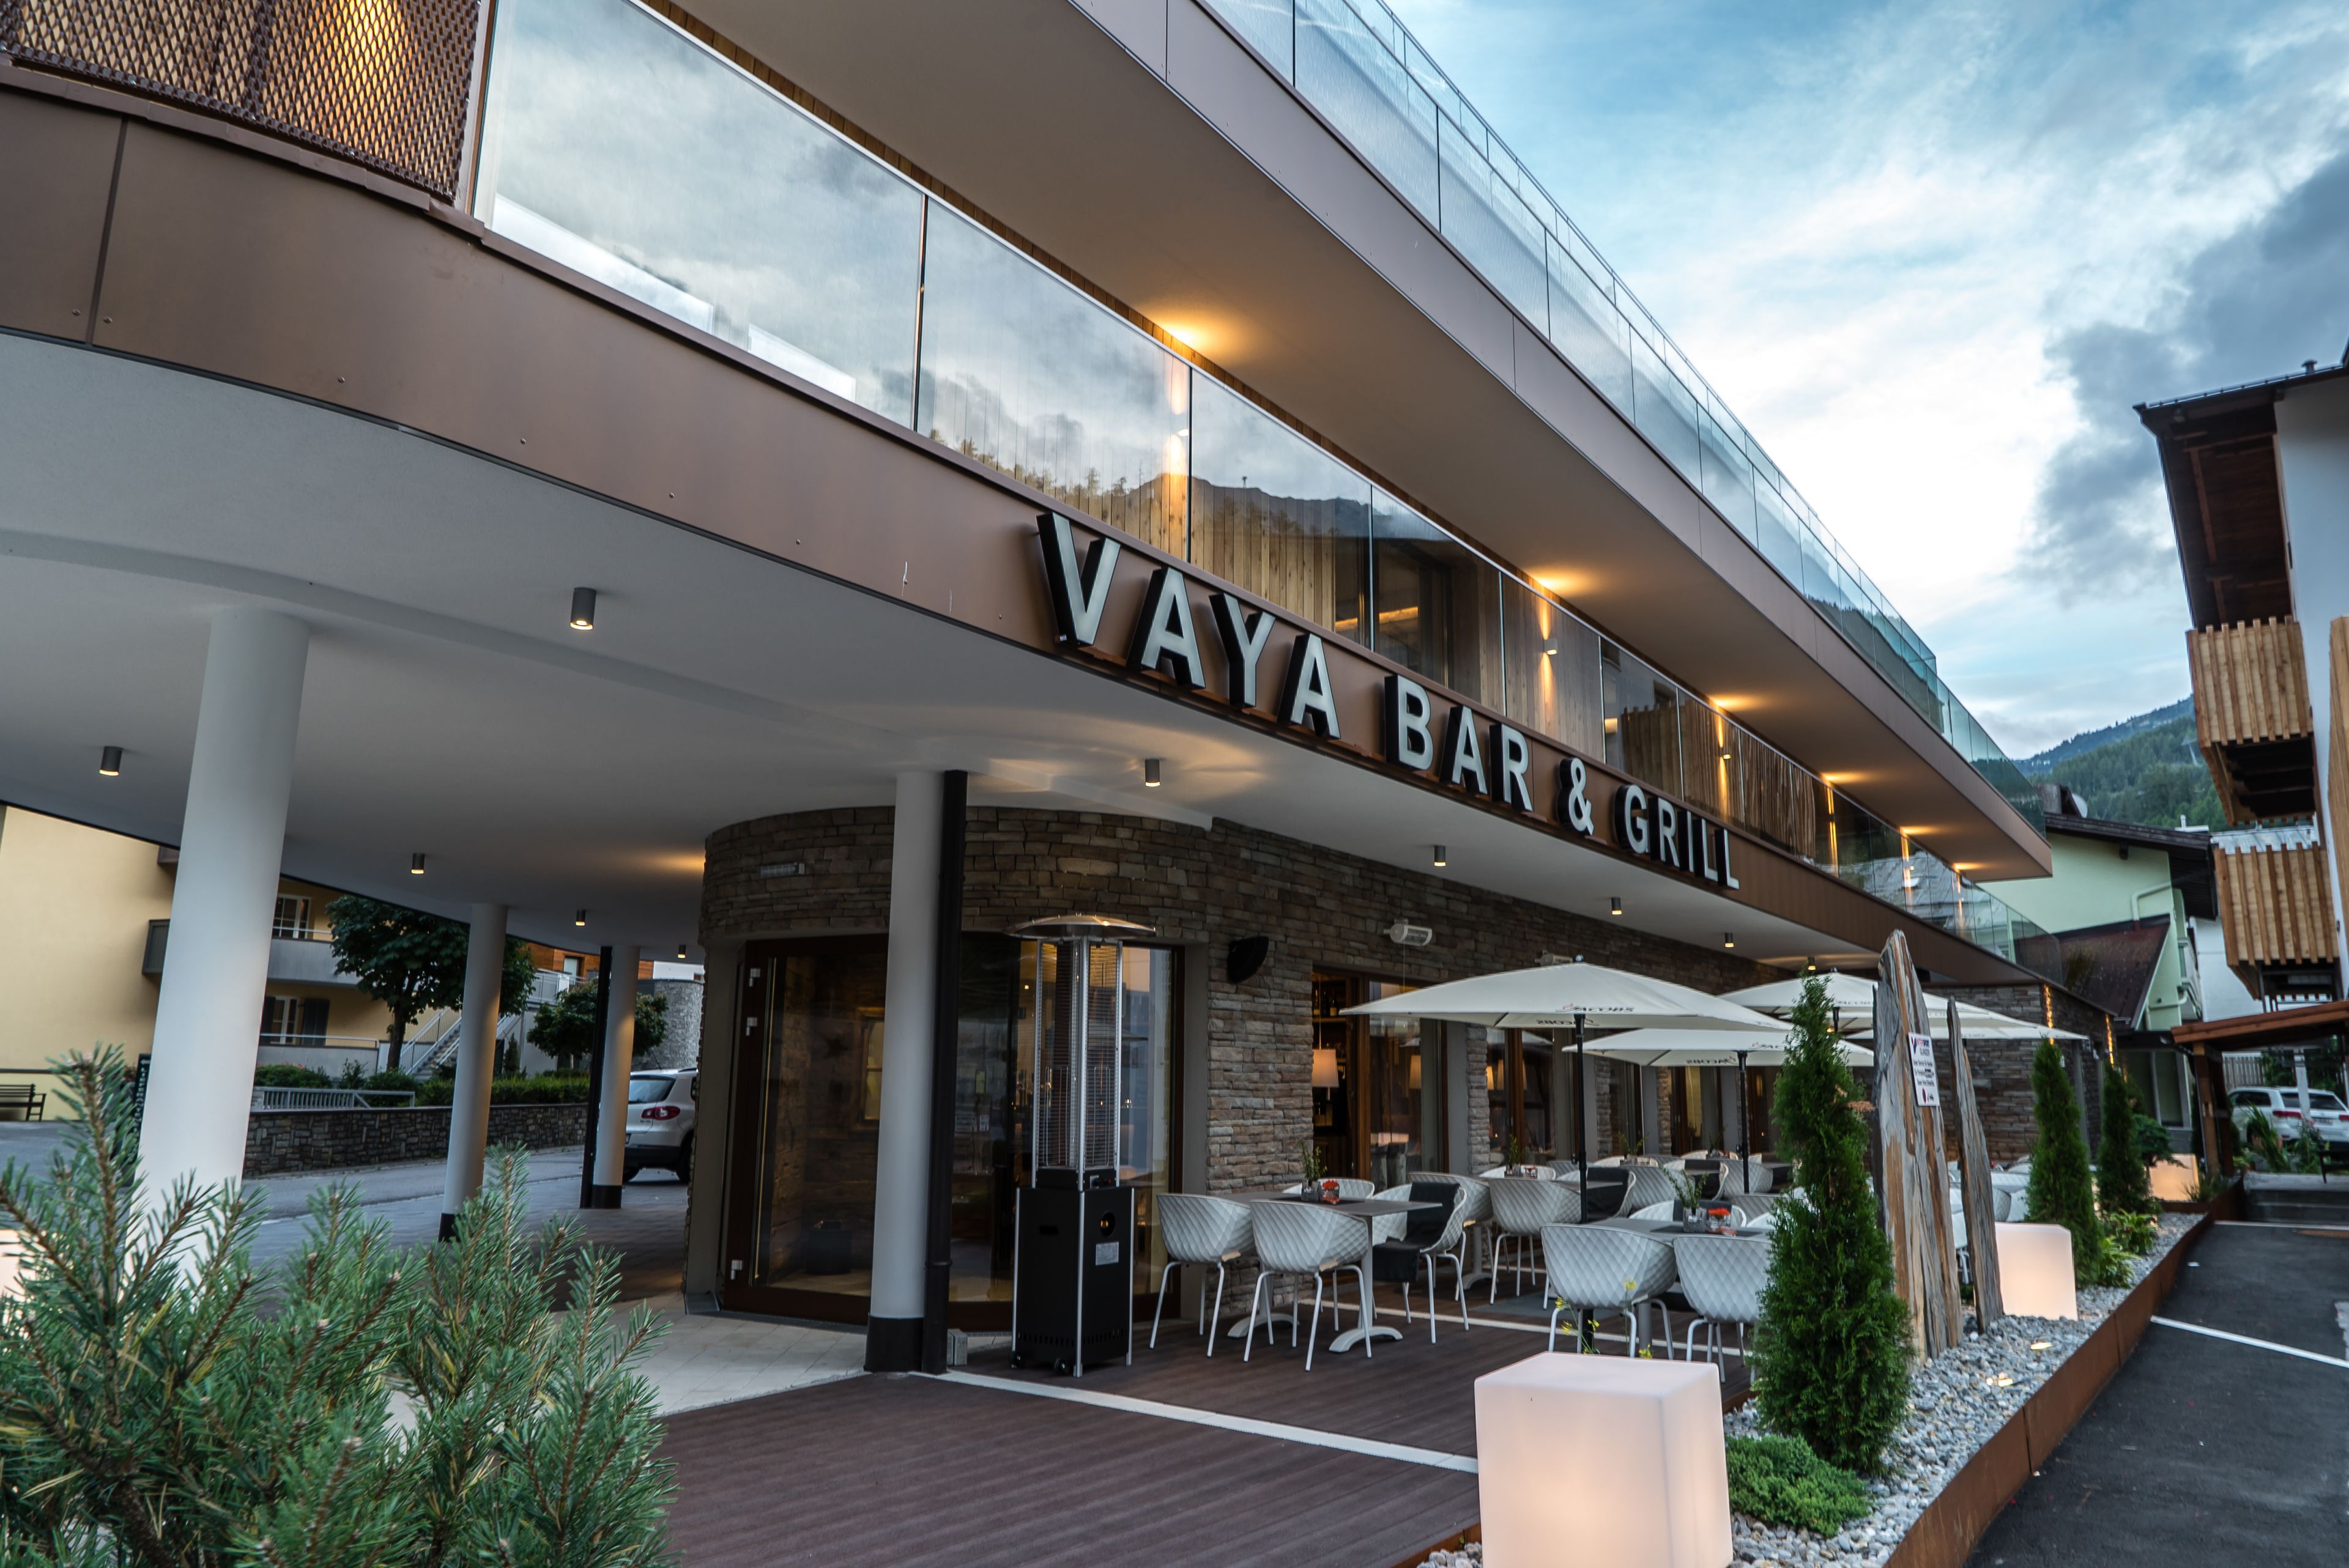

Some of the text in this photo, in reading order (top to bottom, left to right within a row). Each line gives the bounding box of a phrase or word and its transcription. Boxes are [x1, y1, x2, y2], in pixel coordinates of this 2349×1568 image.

[1038, 512, 1740, 890] VAYA BAR & GRILL
